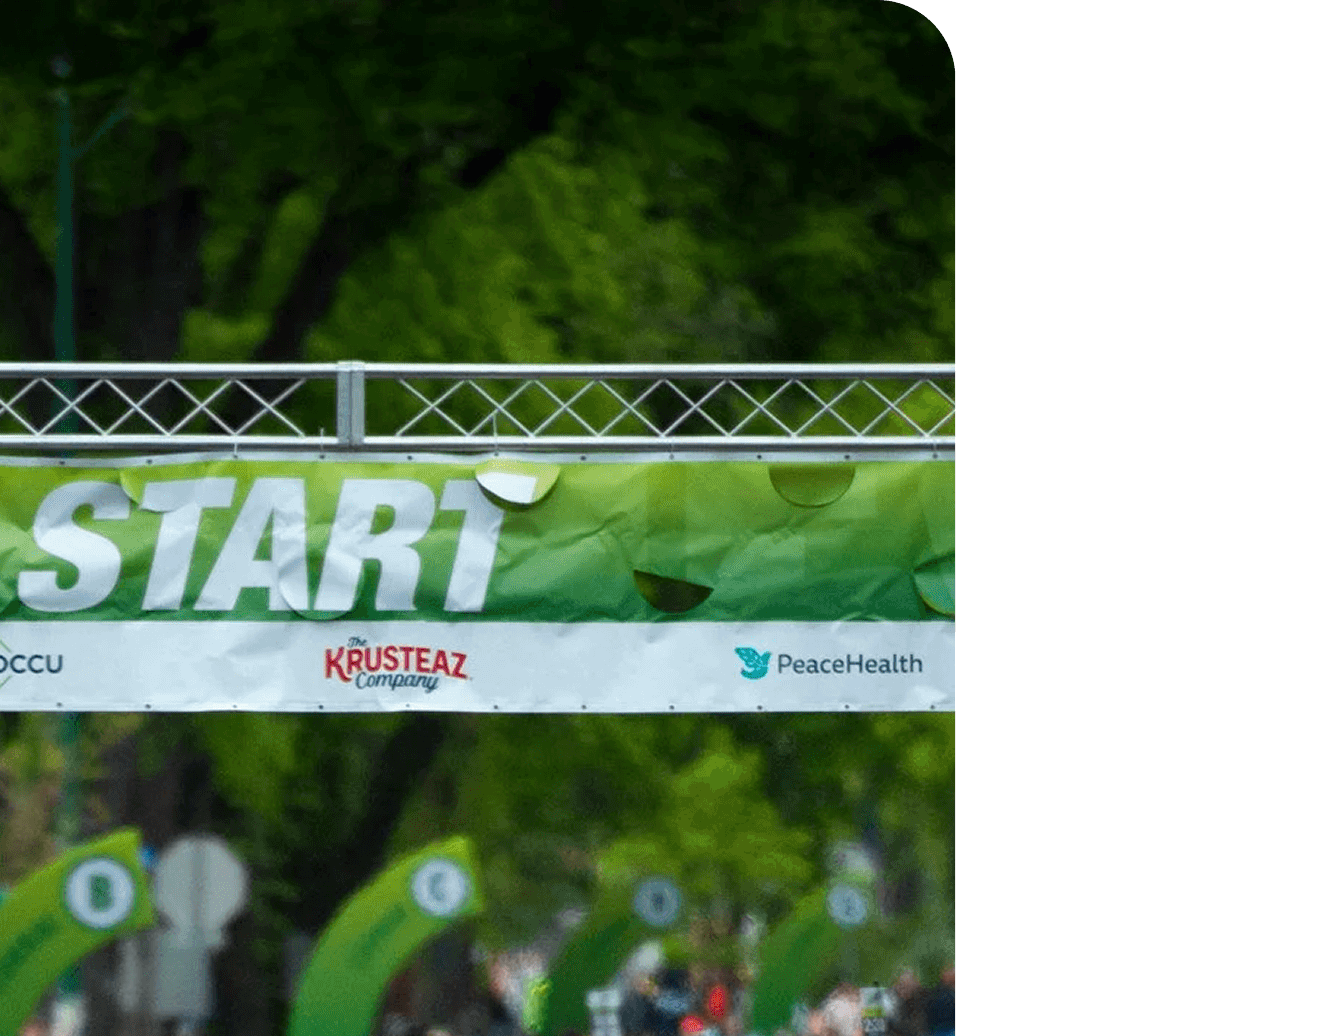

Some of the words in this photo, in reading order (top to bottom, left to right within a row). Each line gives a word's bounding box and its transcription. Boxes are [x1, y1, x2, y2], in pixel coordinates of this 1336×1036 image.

[17, 474, 536, 613] START
[347, 636, 367, 648] The
[324, 645, 467, 682] KRUSTEAZ
[777, 654, 923, 674] PeaceHealth
[355, 672, 439, 694] Company
